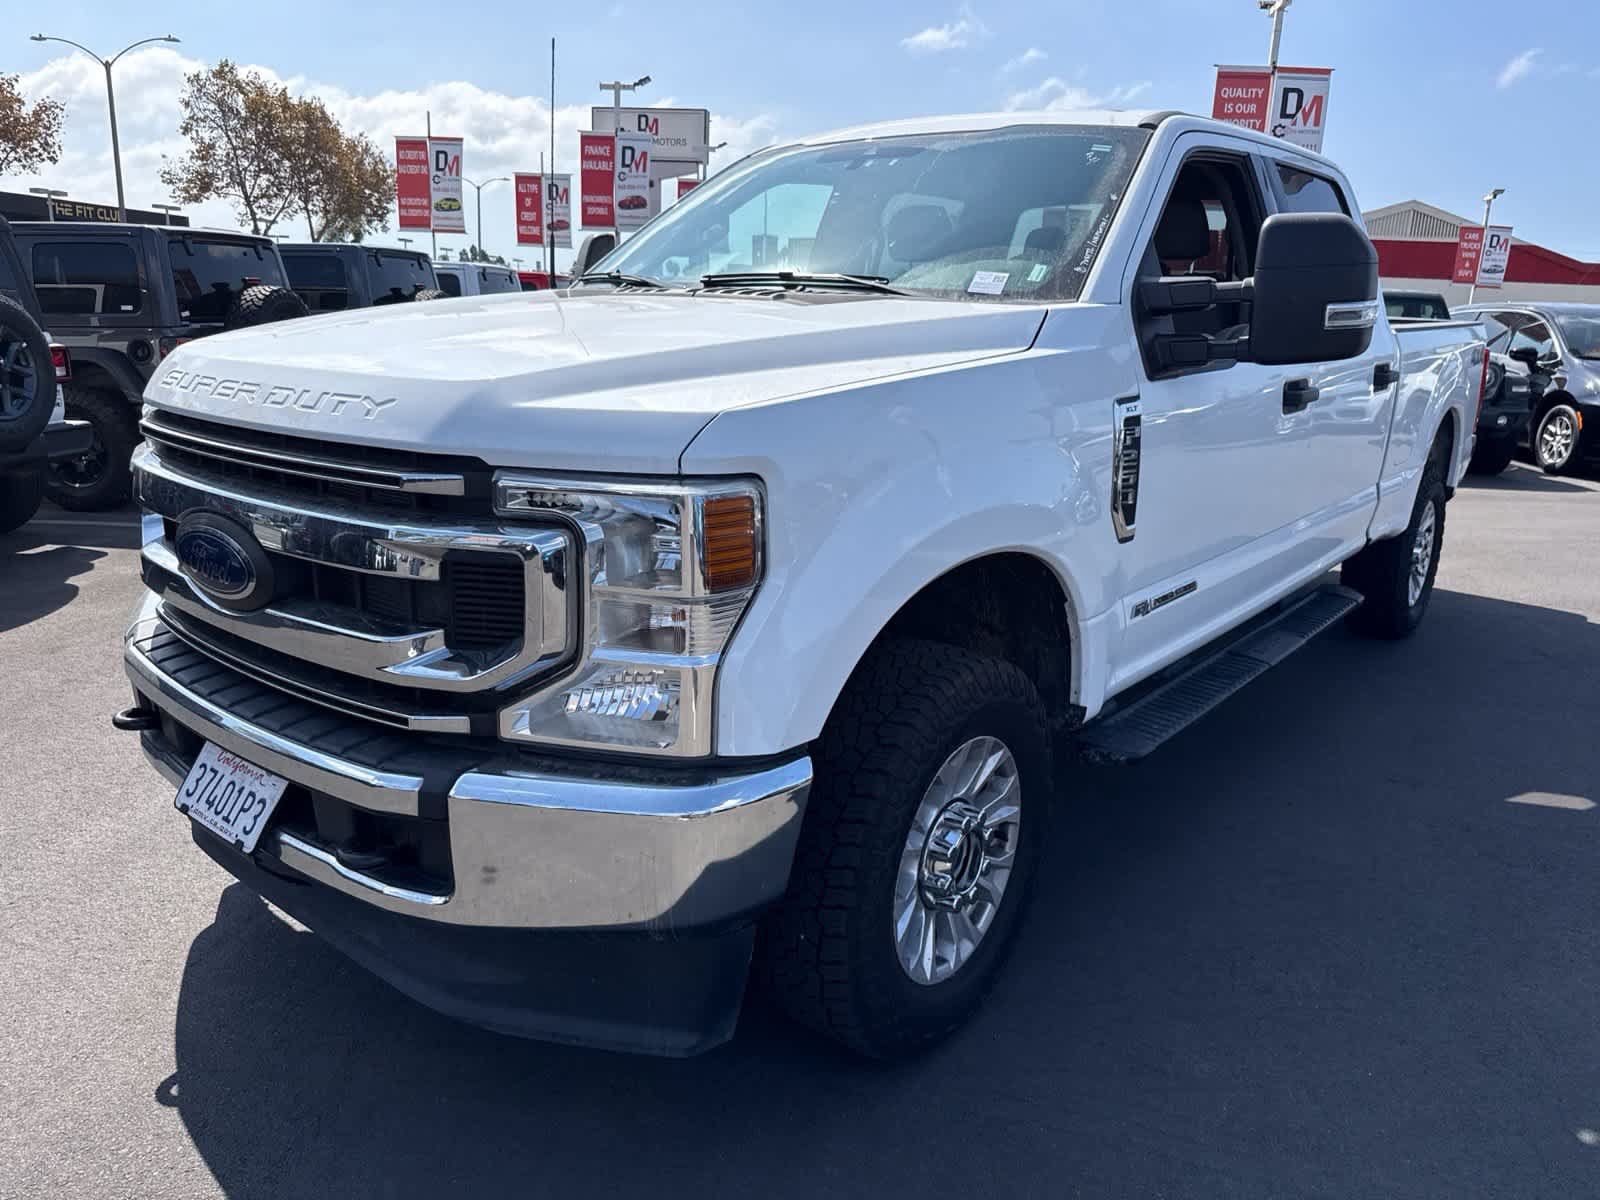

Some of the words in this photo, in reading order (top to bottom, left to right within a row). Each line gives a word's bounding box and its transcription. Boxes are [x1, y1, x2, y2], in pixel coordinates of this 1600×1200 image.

[1221, 87, 1265, 98] QUALITY
[1224, 103, 1233, 113] IS
[1235, 103, 1257, 113] OUR
[652, 137, 687, 146] MOTORS
[584, 145, 611, 156] FINANCE
[582, 160, 614, 171] AVAILABLE
[75, 205, 94, 219] FIT
[160, 368, 261, 404] SUPER
[263, 385, 399, 421] DUTY
[216, 750, 267, 787] California
[186, 762, 267, 836] 37401P3
